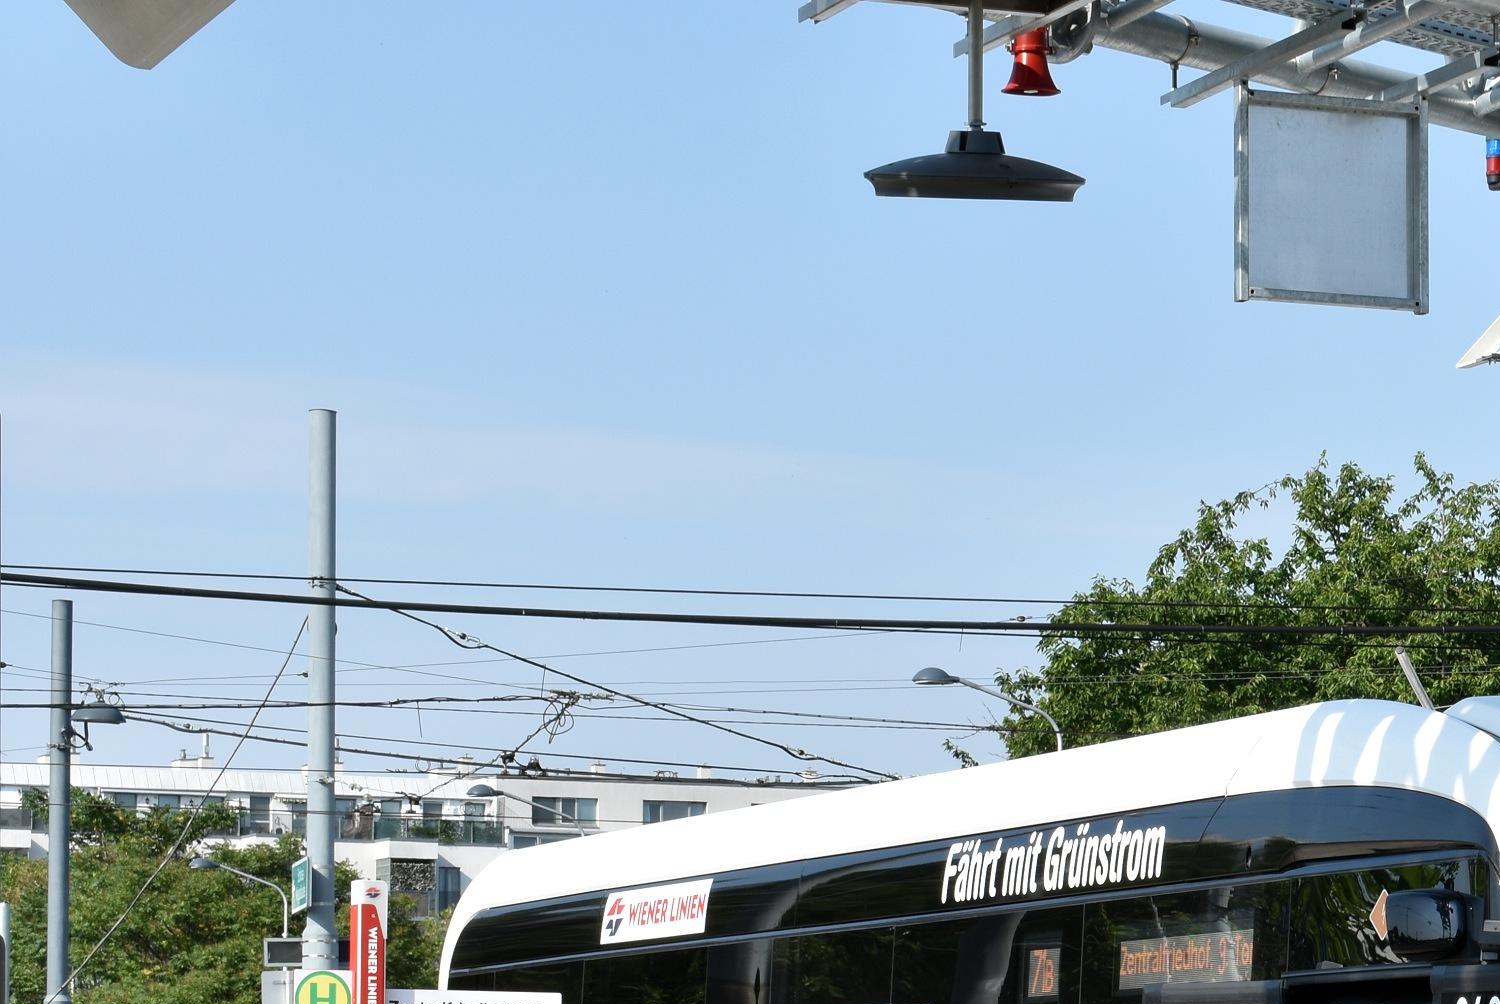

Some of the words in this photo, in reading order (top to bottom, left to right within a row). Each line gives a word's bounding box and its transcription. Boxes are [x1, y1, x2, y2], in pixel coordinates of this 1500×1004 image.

[942, 838, 1003, 904] Fährt
[1002, 831, 1043, 897] mit
[1043, 819, 1166, 892] Grünstrom
[629, 898, 669, 926] WIENER
[669, 893, 707, 922] LINIEN
[368, 926, 378, 974] WIENER
